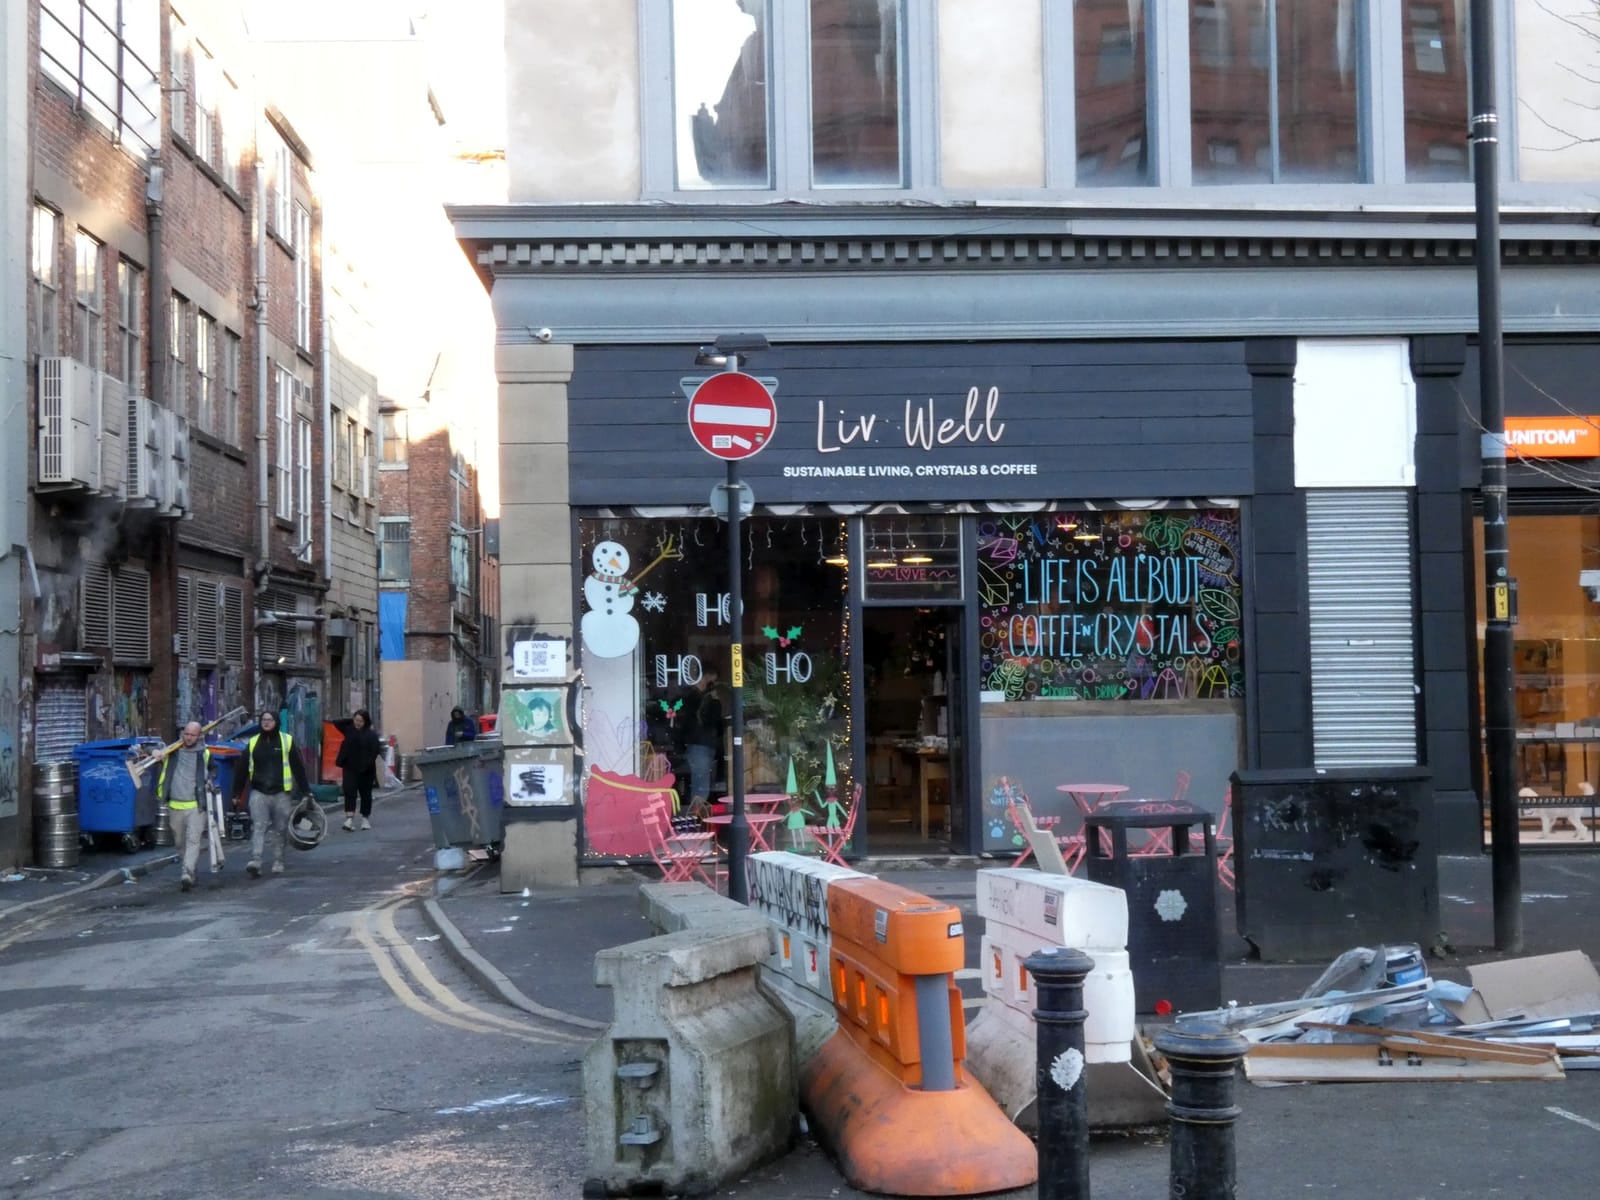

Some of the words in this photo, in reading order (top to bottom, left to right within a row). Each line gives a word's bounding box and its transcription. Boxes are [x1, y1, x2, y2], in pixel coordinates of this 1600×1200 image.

[817, 400, 877, 453] Liv
[904, 386, 1005, 451] Well
[783, 466, 866, 477] SUSTAINABLE
[868, 465, 914, 478] LIVING,
[915, 465, 978, 476] CRYSTALS
[980, 464, 989, 475] &
[990, 464, 1038, 475] COFFEE
[1024, 559, 1070, 604] LIFE
[1076, 559, 1100, 604] IS
[1008, 614, 1084, 657] COFFEE
[1094, 613, 1212, 656] CRYSTALS
[655, 654, 703, 687] HO
[765, 652, 812, 685] HO
[1082, 685, 1093, 699] A
